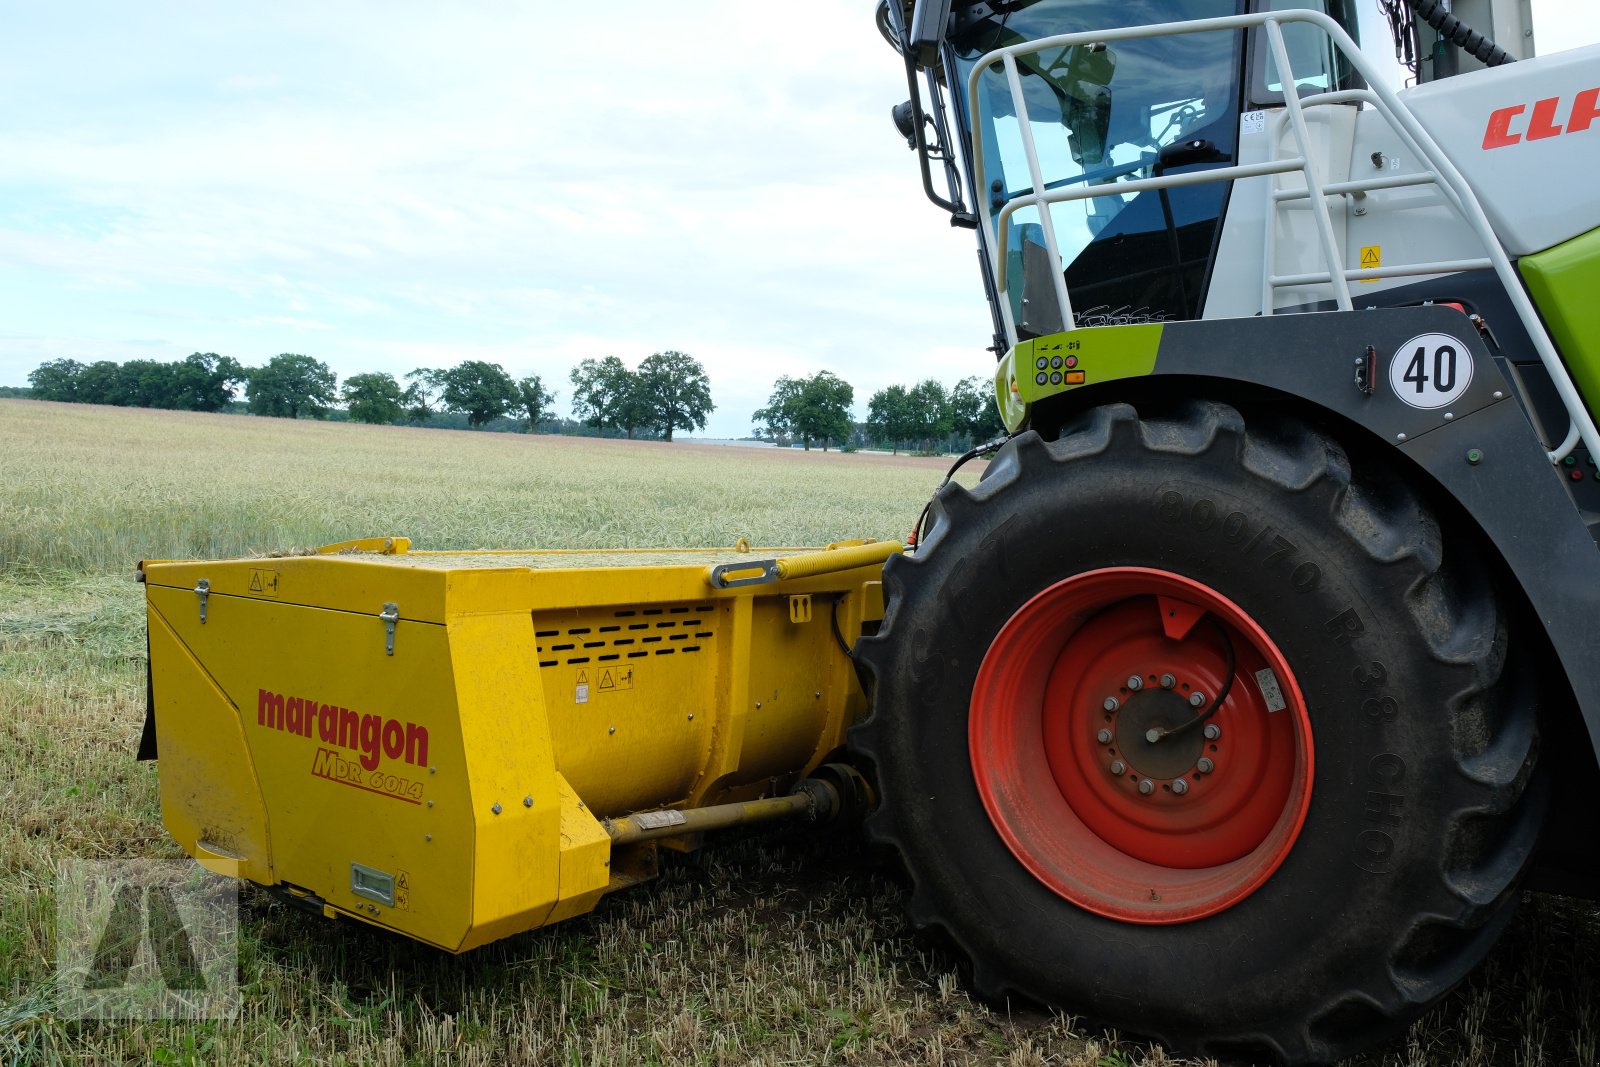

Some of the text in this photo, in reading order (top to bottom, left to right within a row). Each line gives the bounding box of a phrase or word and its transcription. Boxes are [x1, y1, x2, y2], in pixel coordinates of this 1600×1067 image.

[1402, 345, 1457, 394] 40
[1159, 491, 1407, 864] 800/70 R 38 CHO
[257, 688, 429, 771] marangon
[311, 747, 424, 800] MDR 6014
